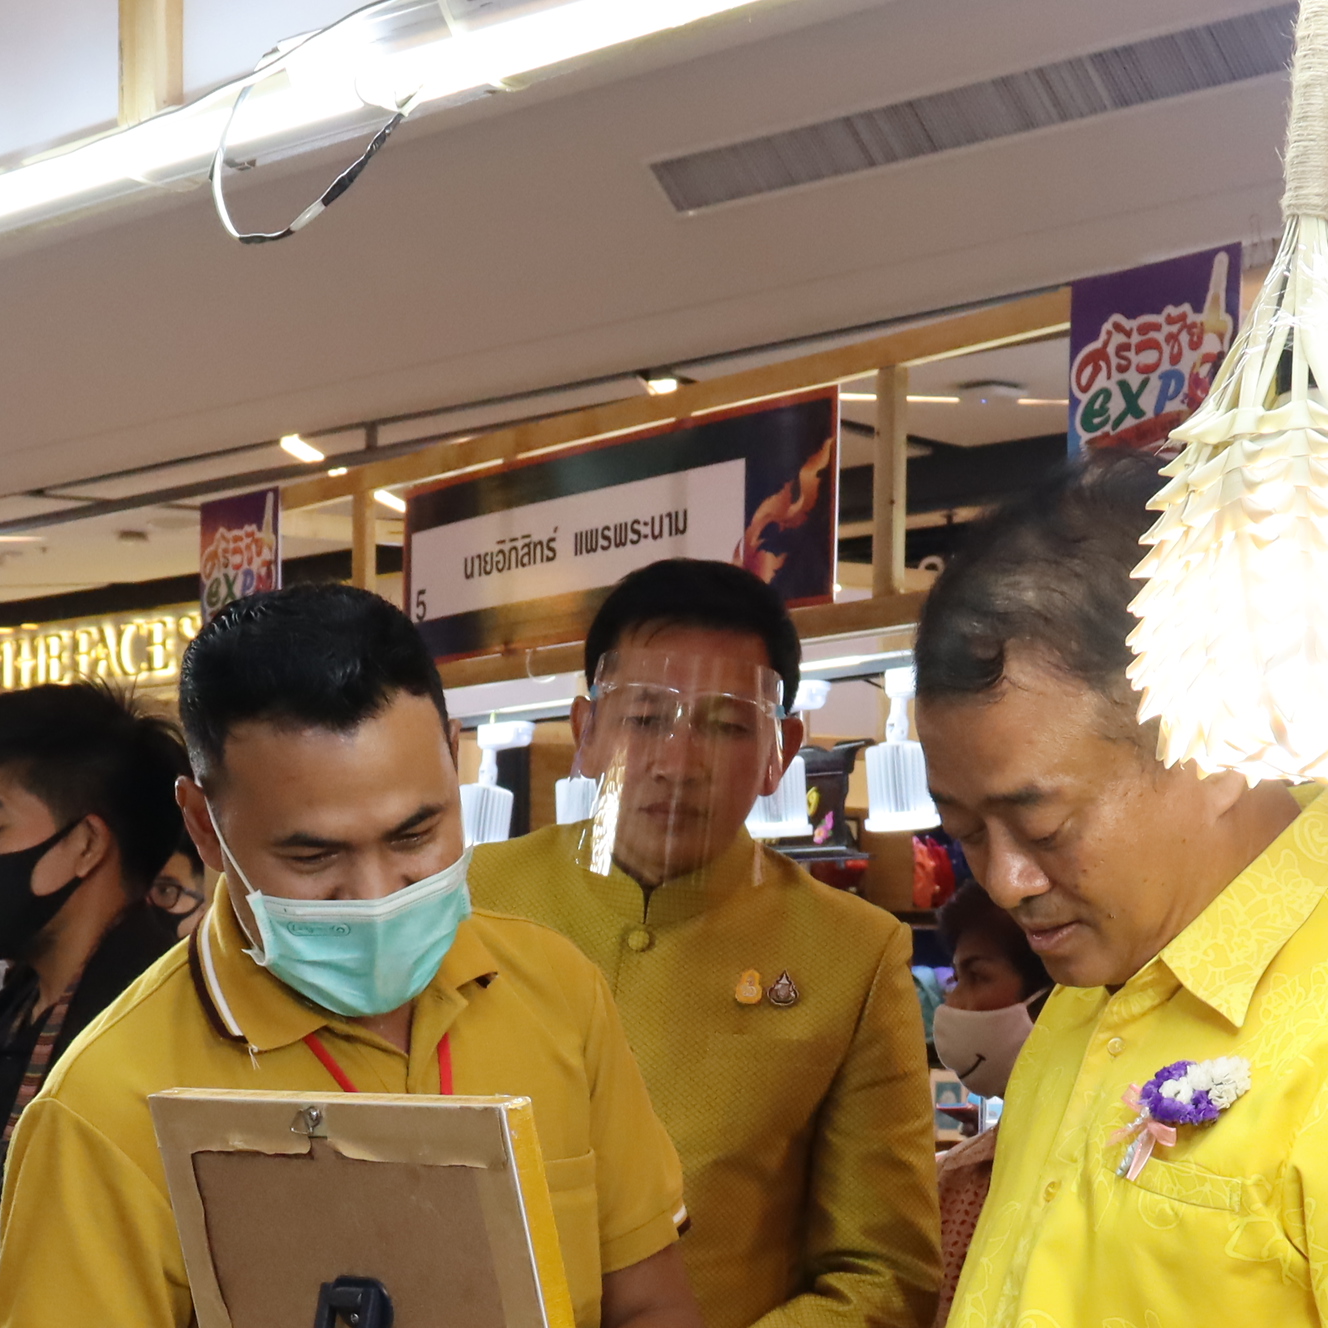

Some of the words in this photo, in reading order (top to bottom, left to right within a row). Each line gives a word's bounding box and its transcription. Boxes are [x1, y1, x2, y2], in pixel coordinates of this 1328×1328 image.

[573, 508, 688, 557] แพรพระนาม
[415, 588, 427, 621] 5
